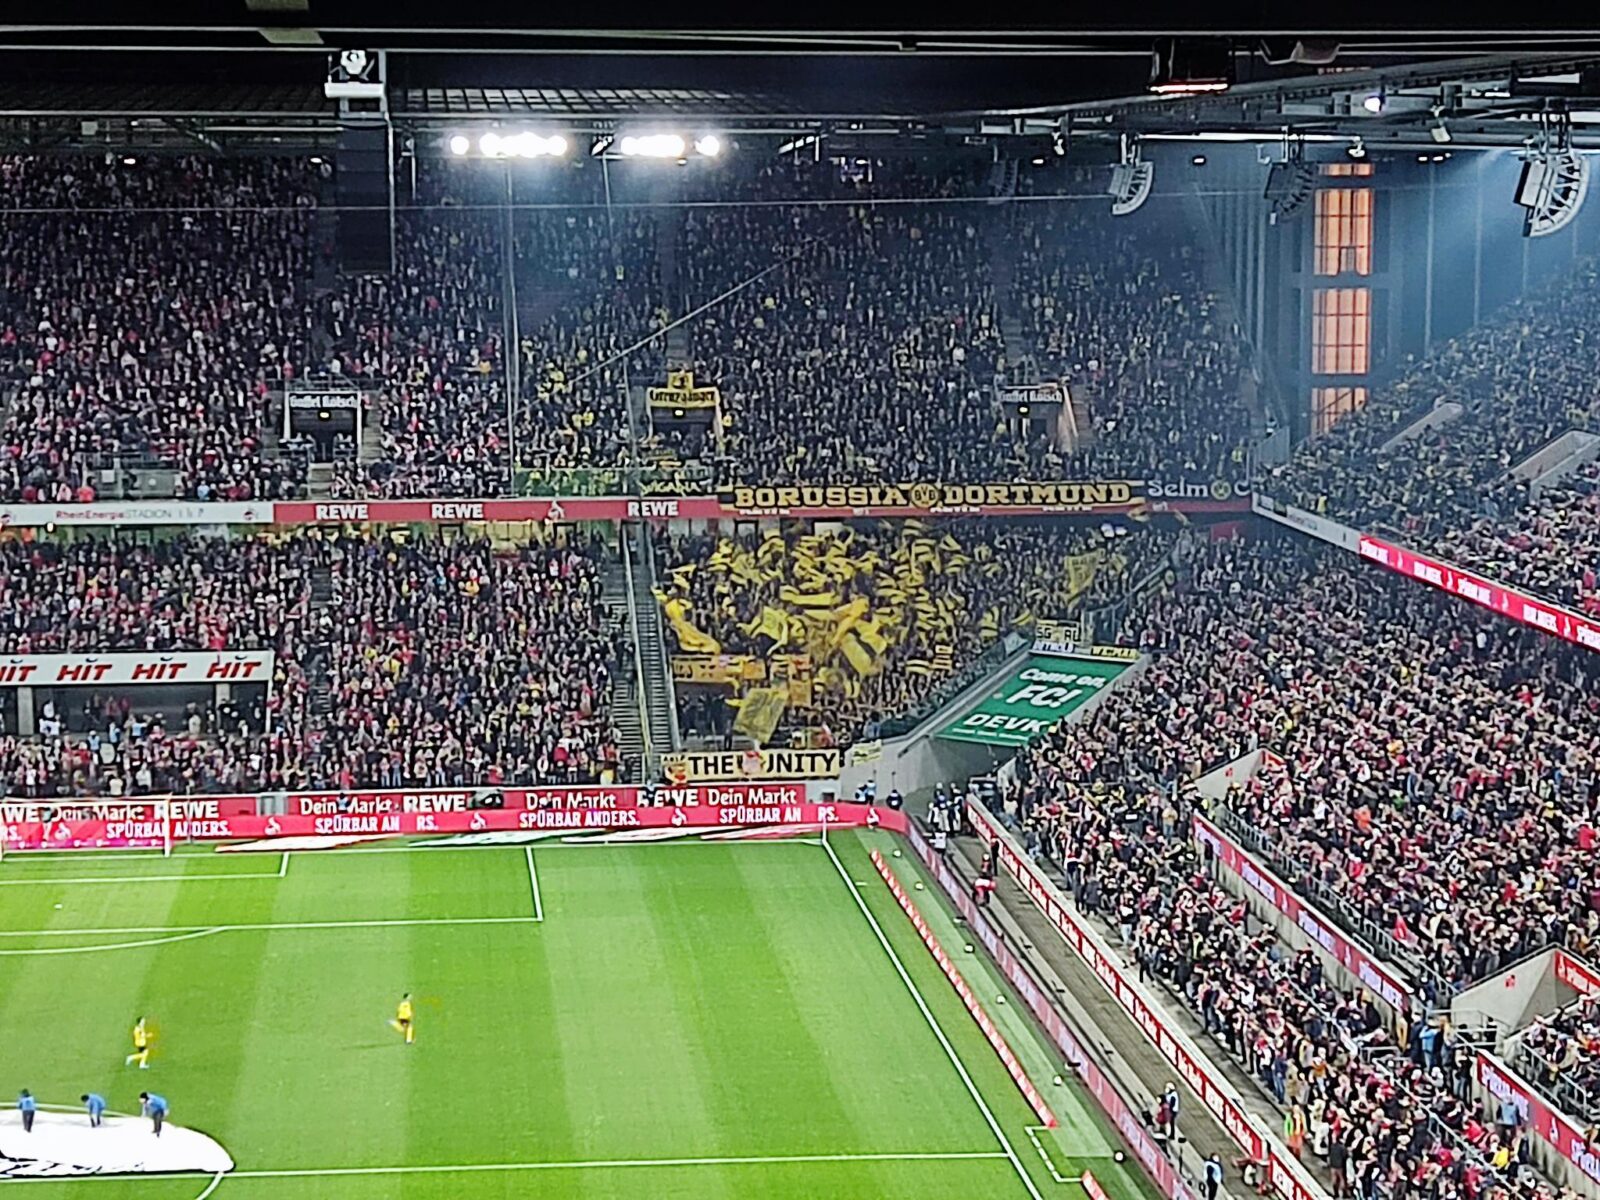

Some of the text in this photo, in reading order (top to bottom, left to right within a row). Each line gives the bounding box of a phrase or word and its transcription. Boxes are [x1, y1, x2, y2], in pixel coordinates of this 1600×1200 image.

[734, 486, 906, 508] BORUSSIA
[943, 483, 1132, 504] DORTMUND
[1147, 476, 1209, 497] Selm
[316, 504, 369, 521] REWE
[431, 502, 484, 519] REWE
[627, 500, 679, 517] REWE
[56, 663, 113, 681] HIT
[131, 662, 187, 680] HIT
[206, 661, 262, 679] HIT
[1018, 668, 1072, 684] Come
[1006, 684, 1082, 708] FC!
[963, 713, 1051, 733] DEVK
[688, 754, 734, 775] THE
[300, 796, 337, 815] Dein
[402, 794, 467, 813] REWE
[707, 786, 797, 806] Dein Markt
[519, 808, 641, 828] SPÜRBAR ANDERS.
[719, 805, 781, 824] SPÜRBAR
[314, 815, 379, 834] SPÜRBAR
